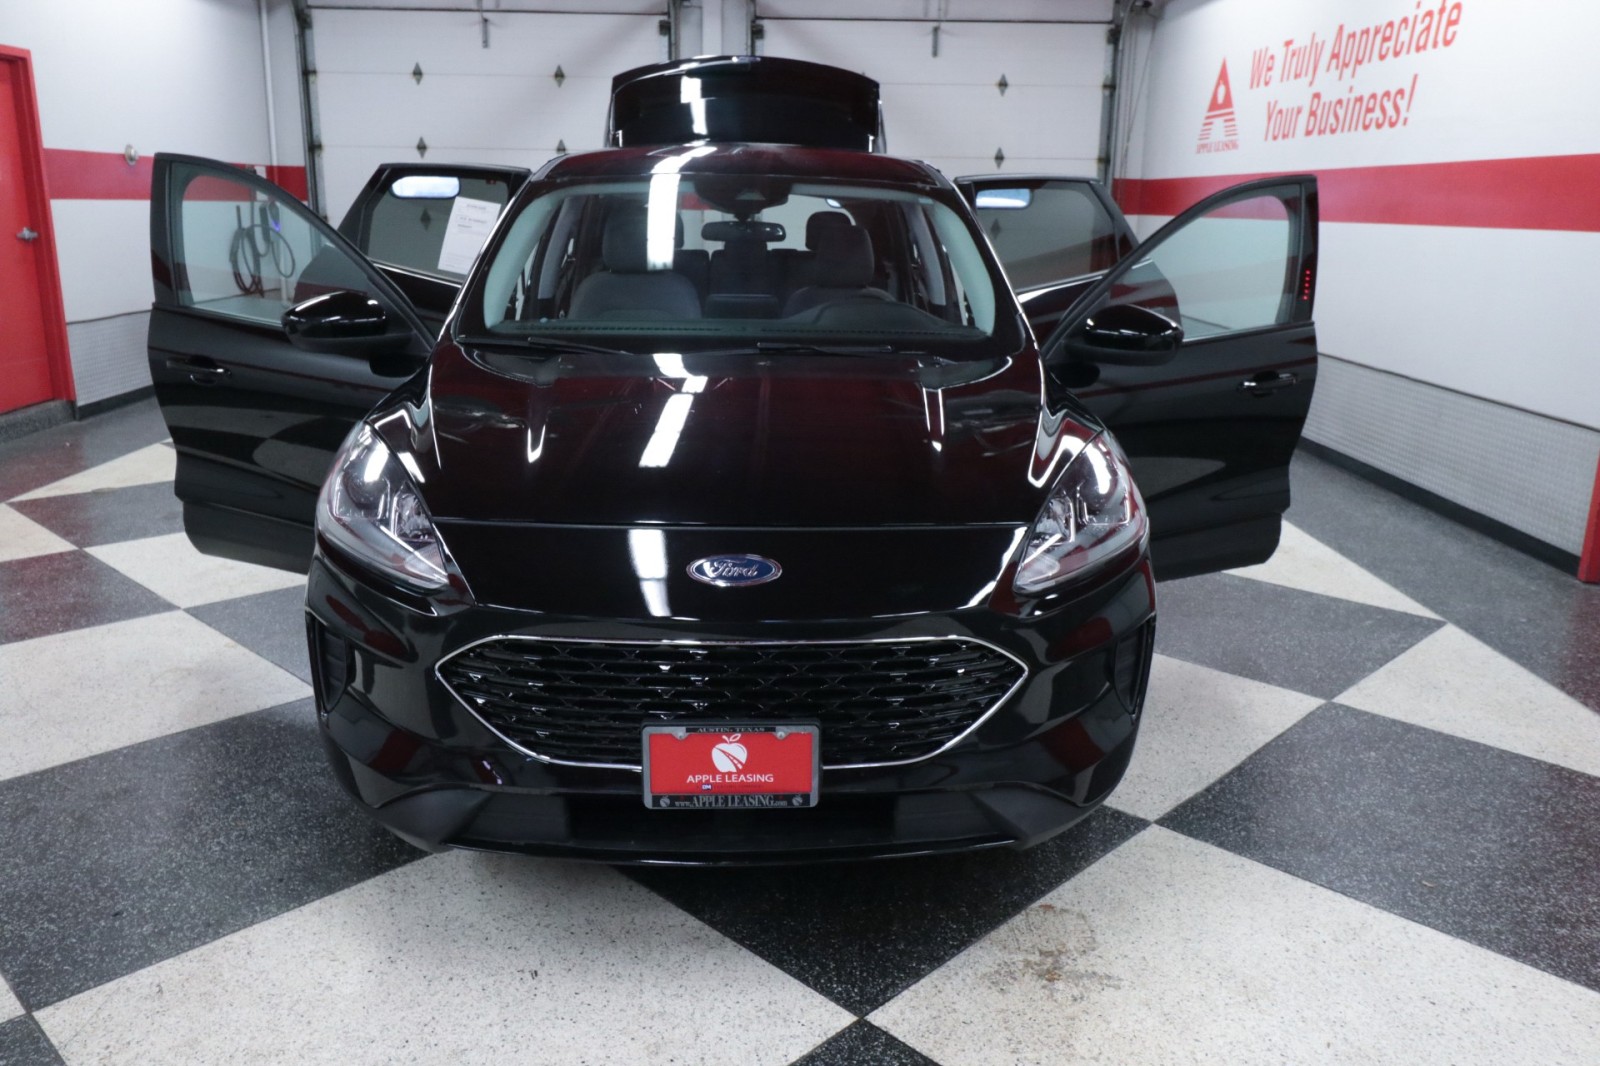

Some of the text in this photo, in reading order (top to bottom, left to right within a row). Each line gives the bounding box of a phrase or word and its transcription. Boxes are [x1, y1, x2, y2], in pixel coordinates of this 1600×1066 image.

[1250, 0, 1463, 89] We Truly Appreciate
[1264, 74, 1418, 141] Your Business!
[709, 561, 758, 577] Ford
[686, 773, 774, 783] APPLE LEASING
